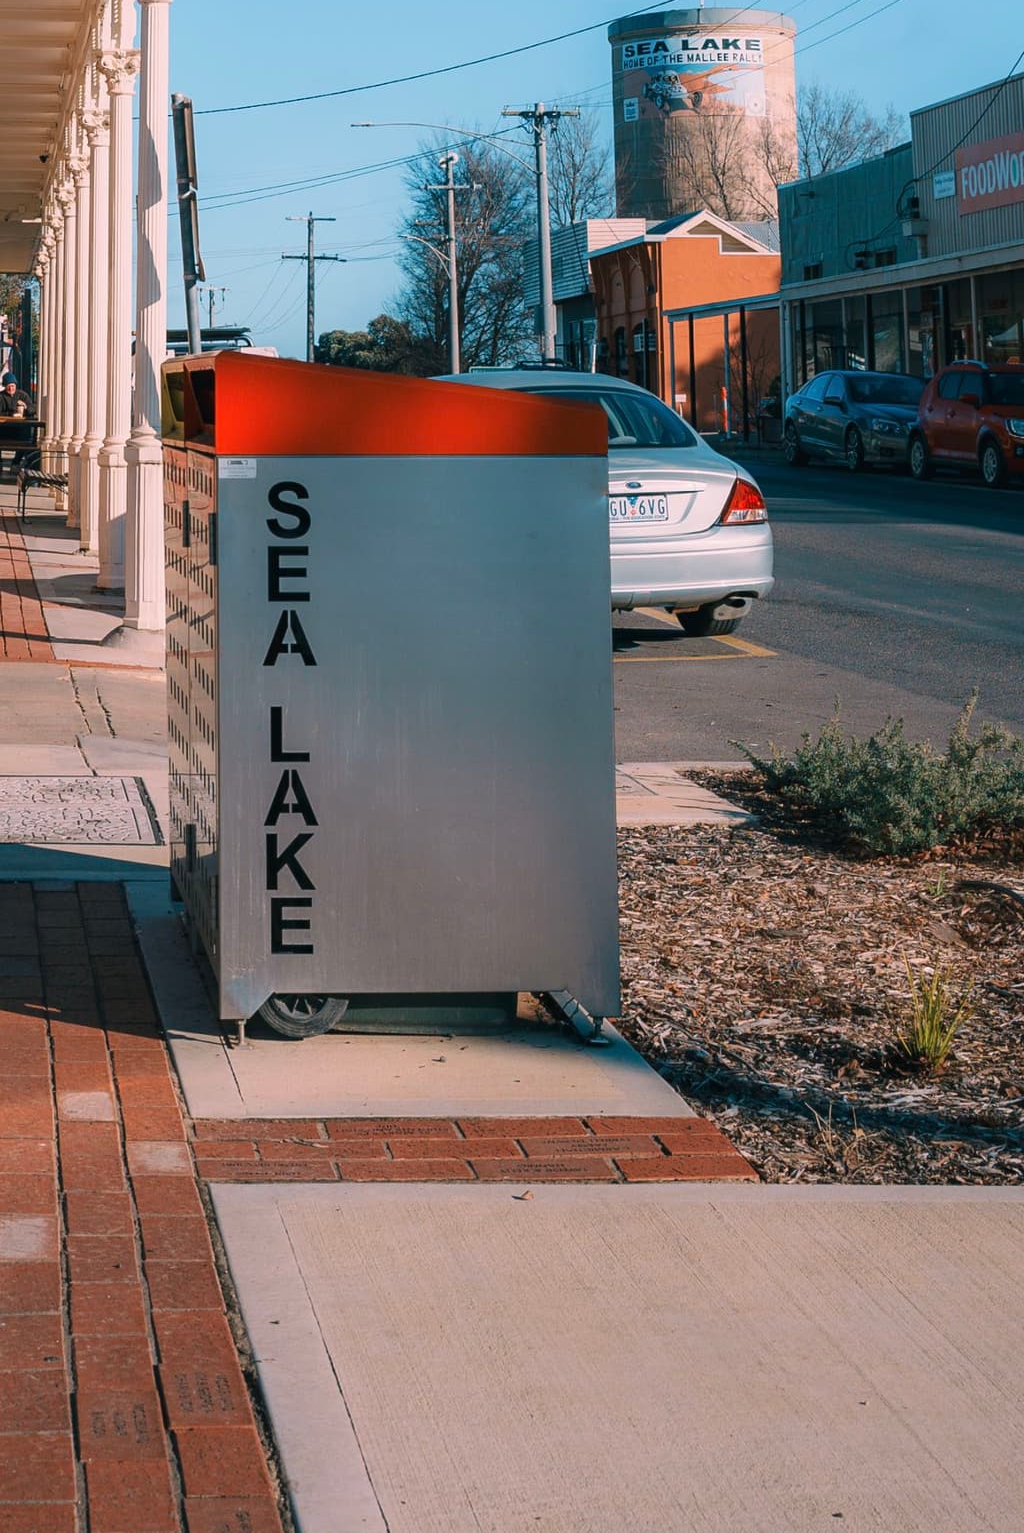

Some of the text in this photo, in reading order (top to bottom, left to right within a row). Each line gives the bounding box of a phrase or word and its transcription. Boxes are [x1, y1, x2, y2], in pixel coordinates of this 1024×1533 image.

[624, 39, 761, 58] SEA LAKE
[623, 58, 646, 70] HOME
[647, 56, 658, 66] OF
[661, 53, 683, 64] THE
[687, 52, 729, 63] MALLEE
[262, 480, 319, 955] SEA LAKE
